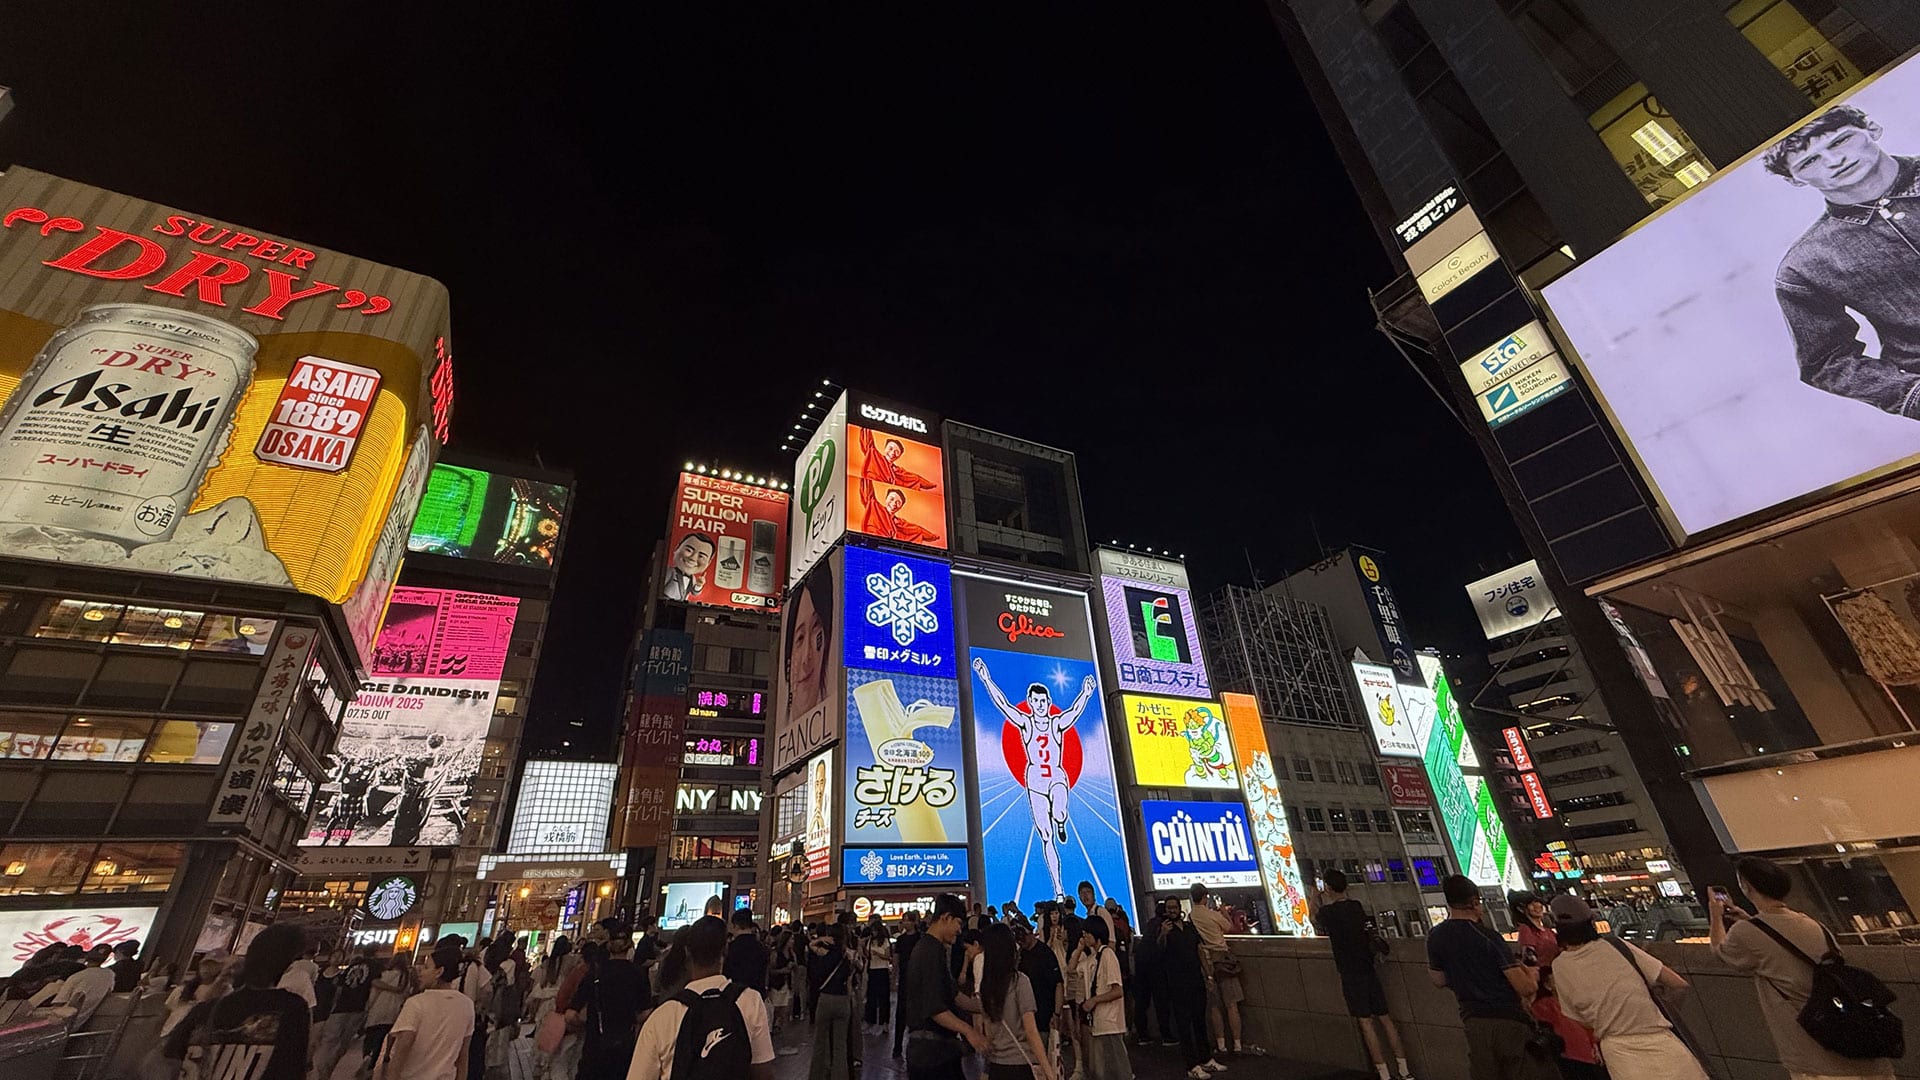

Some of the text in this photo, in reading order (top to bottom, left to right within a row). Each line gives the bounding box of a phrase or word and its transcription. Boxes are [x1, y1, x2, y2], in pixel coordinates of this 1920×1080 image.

[153, 214, 316, 271] SUPER
[1431, 251, 1490, 295] Colors Beauty
[132, 342, 193, 362] SUPER
[290, 364, 376, 402] ASAHI
[1515, 368, 1542, 386] NIKKEN
[1518, 377, 1541, 391] TOTAL
[1519, 373, 1558, 396] SOURCING
[33, 369, 221, 434] Asahi
[307, 392, 346, 408] since
[275, 399, 361, 435] 1889
[87, 422, 136, 446] 生
[261, 428, 347, 466] OSAKA
[37, 453, 150, 479] スーパードライ
[45, 494, 97, 509] 生ビール
[683, 487, 744, 509] SUPER
[136, 504, 175, 528] お酒
[681, 500, 748, 524] MILLION
[679, 515, 726, 534] HAIR
[455, 593, 500, 601] OFFICIAL
[734, 594, 759, 603] ルアン
[1484, 576, 1536, 603] フジ住宅
[998, 612, 1065, 642] Glico
[864, 645, 942, 666] 雪印メグミルク
[261, 654, 296, 715] 本場の味
[392, 684, 490, 700] DANDISM
[396, 697, 425, 710] 2025
[1136, 701, 1172, 717] かぜに
[371, 710, 391, 721] OUT
[1135, 715, 1183, 738] 改源
[777, 708, 833, 767] FANCL
[1506, 729, 1526, 764] カラオケ
[1036, 735, 1053, 778] グリコ
[216, 721, 273, 816] かに道楽
[855, 766, 958, 808] さける
[1524, 773, 1551, 818] ネットカフェ
[676, 789, 716, 811] NY
[730, 789, 763, 811] NY
[854, 807, 895, 829] チーズ
[890, 853, 903, 861] Love
[904, 853, 922, 861] Earth.
[937, 852, 950, 860] Life.
[886, 862, 954, 878] 雪印メグミルク
[353, 927, 430, 945] TSUTA
